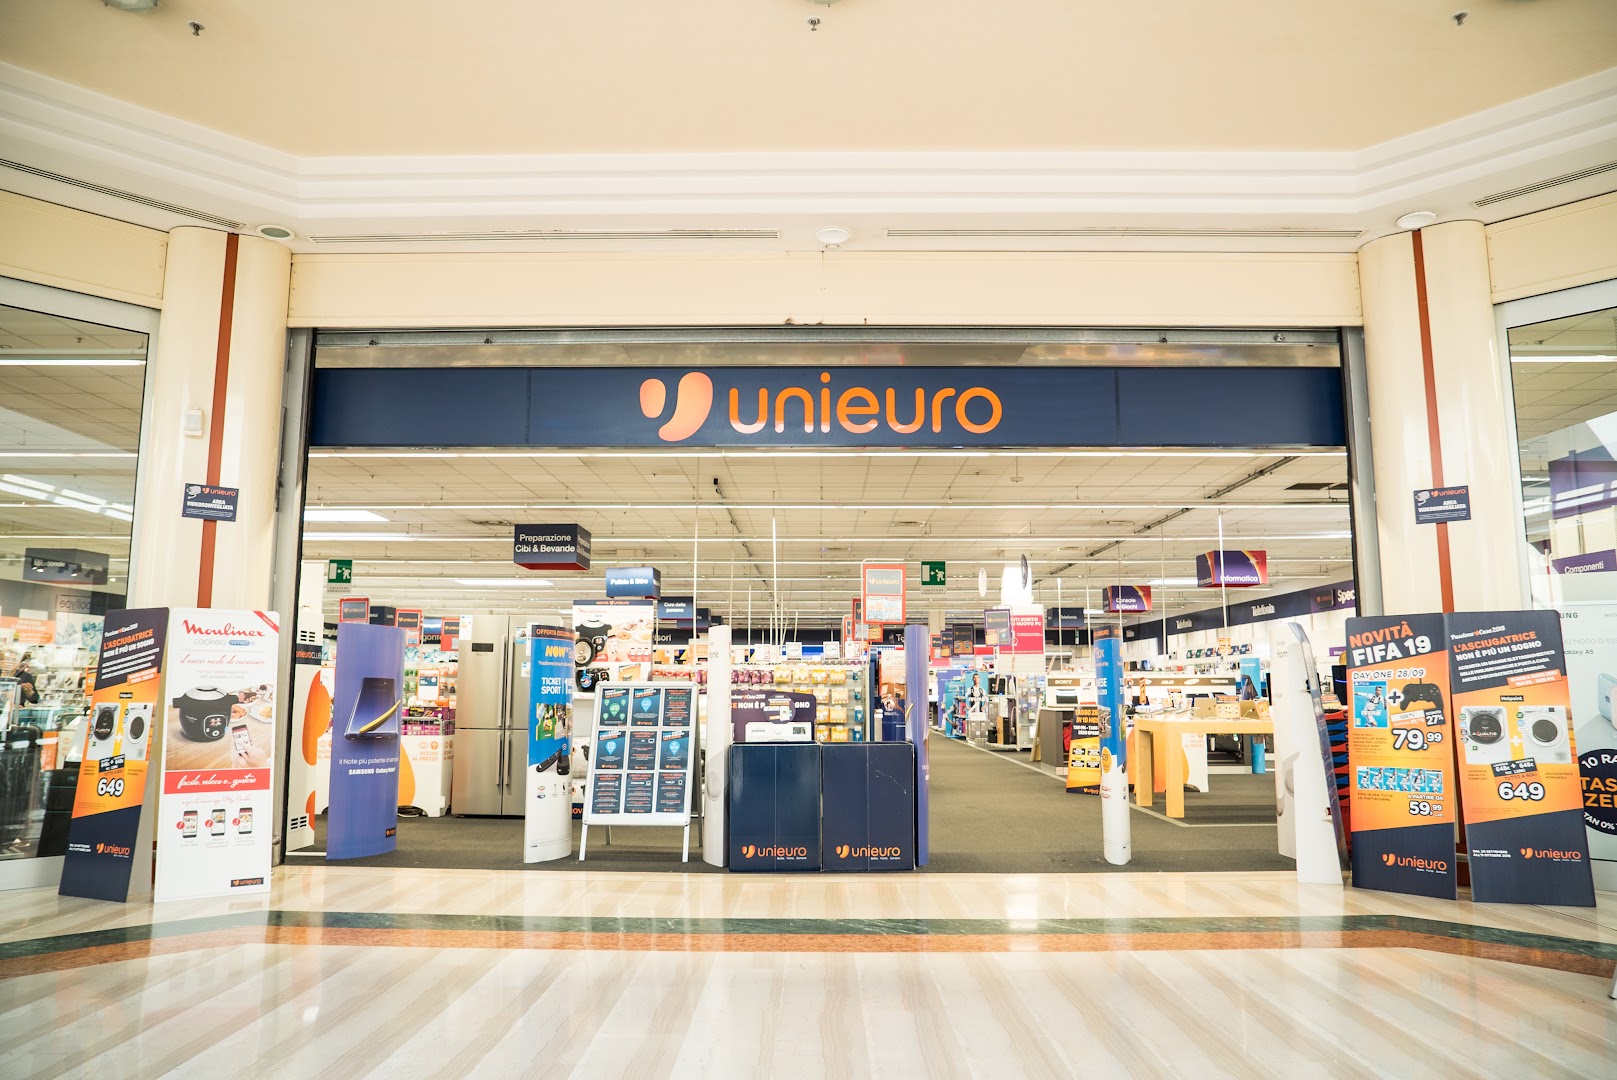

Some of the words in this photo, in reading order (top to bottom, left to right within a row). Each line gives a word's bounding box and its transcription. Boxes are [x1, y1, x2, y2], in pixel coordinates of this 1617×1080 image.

[729, 371, 1002, 434] unieuro
[210, 488, 236, 496] unieuro
[520, 534, 571, 543] Preparazione
[540, 544, 575, 552] Bevande
[1564, 561, 1604, 574] Componenti
[1252, 604, 1275, 616] Telefonia
[182, 620, 265, 636] Moulinex
[1349, 620, 1414, 648] NOVITÀ
[104, 629, 153, 650] L'ASCIUGATRICE
[1453, 631, 1537, 653] L'ASCIUGATRICE
[103, 650, 114, 658] NON
[137, 638, 154, 649] SOGNO
[545, 646, 565, 657] NOW
[1352, 642, 1402, 666] FIFA
[1404, 636, 1431, 655] 19
[1456, 652, 1474, 661] NON
[1475, 649, 1481, 658] È
[1482, 647, 1497, 657] PIÙ
[1498, 646, 1510, 654] UN
[1511, 640, 1542, 652] SOGNO
[1397, 669, 1424, 677] 28/09
[541, 677, 561, 685] TICKET
[541, 686, 561, 694] SPORT
[1426, 715, 1444, 725] 27%
[1391, 728, 1442, 750] 79,99
[1582, 756, 1598, 768] 10
[97, 777, 124, 797] 649
[202, 774, 222, 785] veloce
[230, 773, 256, 788] gustoso
[1498, 782, 1545, 801] 649
[1409, 801, 1442, 816] 59,99
[1584, 812, 1600, 825] TAN
[1601, 821, 1615, 830] 0%
[104, 844, 130, 855] unieuro
[758, 845, 807, 857] unieuro
[852, 844, 900, 857] unieuro
[1535, 848, 1581, 859] unieuro
[1398, 856, 1447, 870] unieuro
